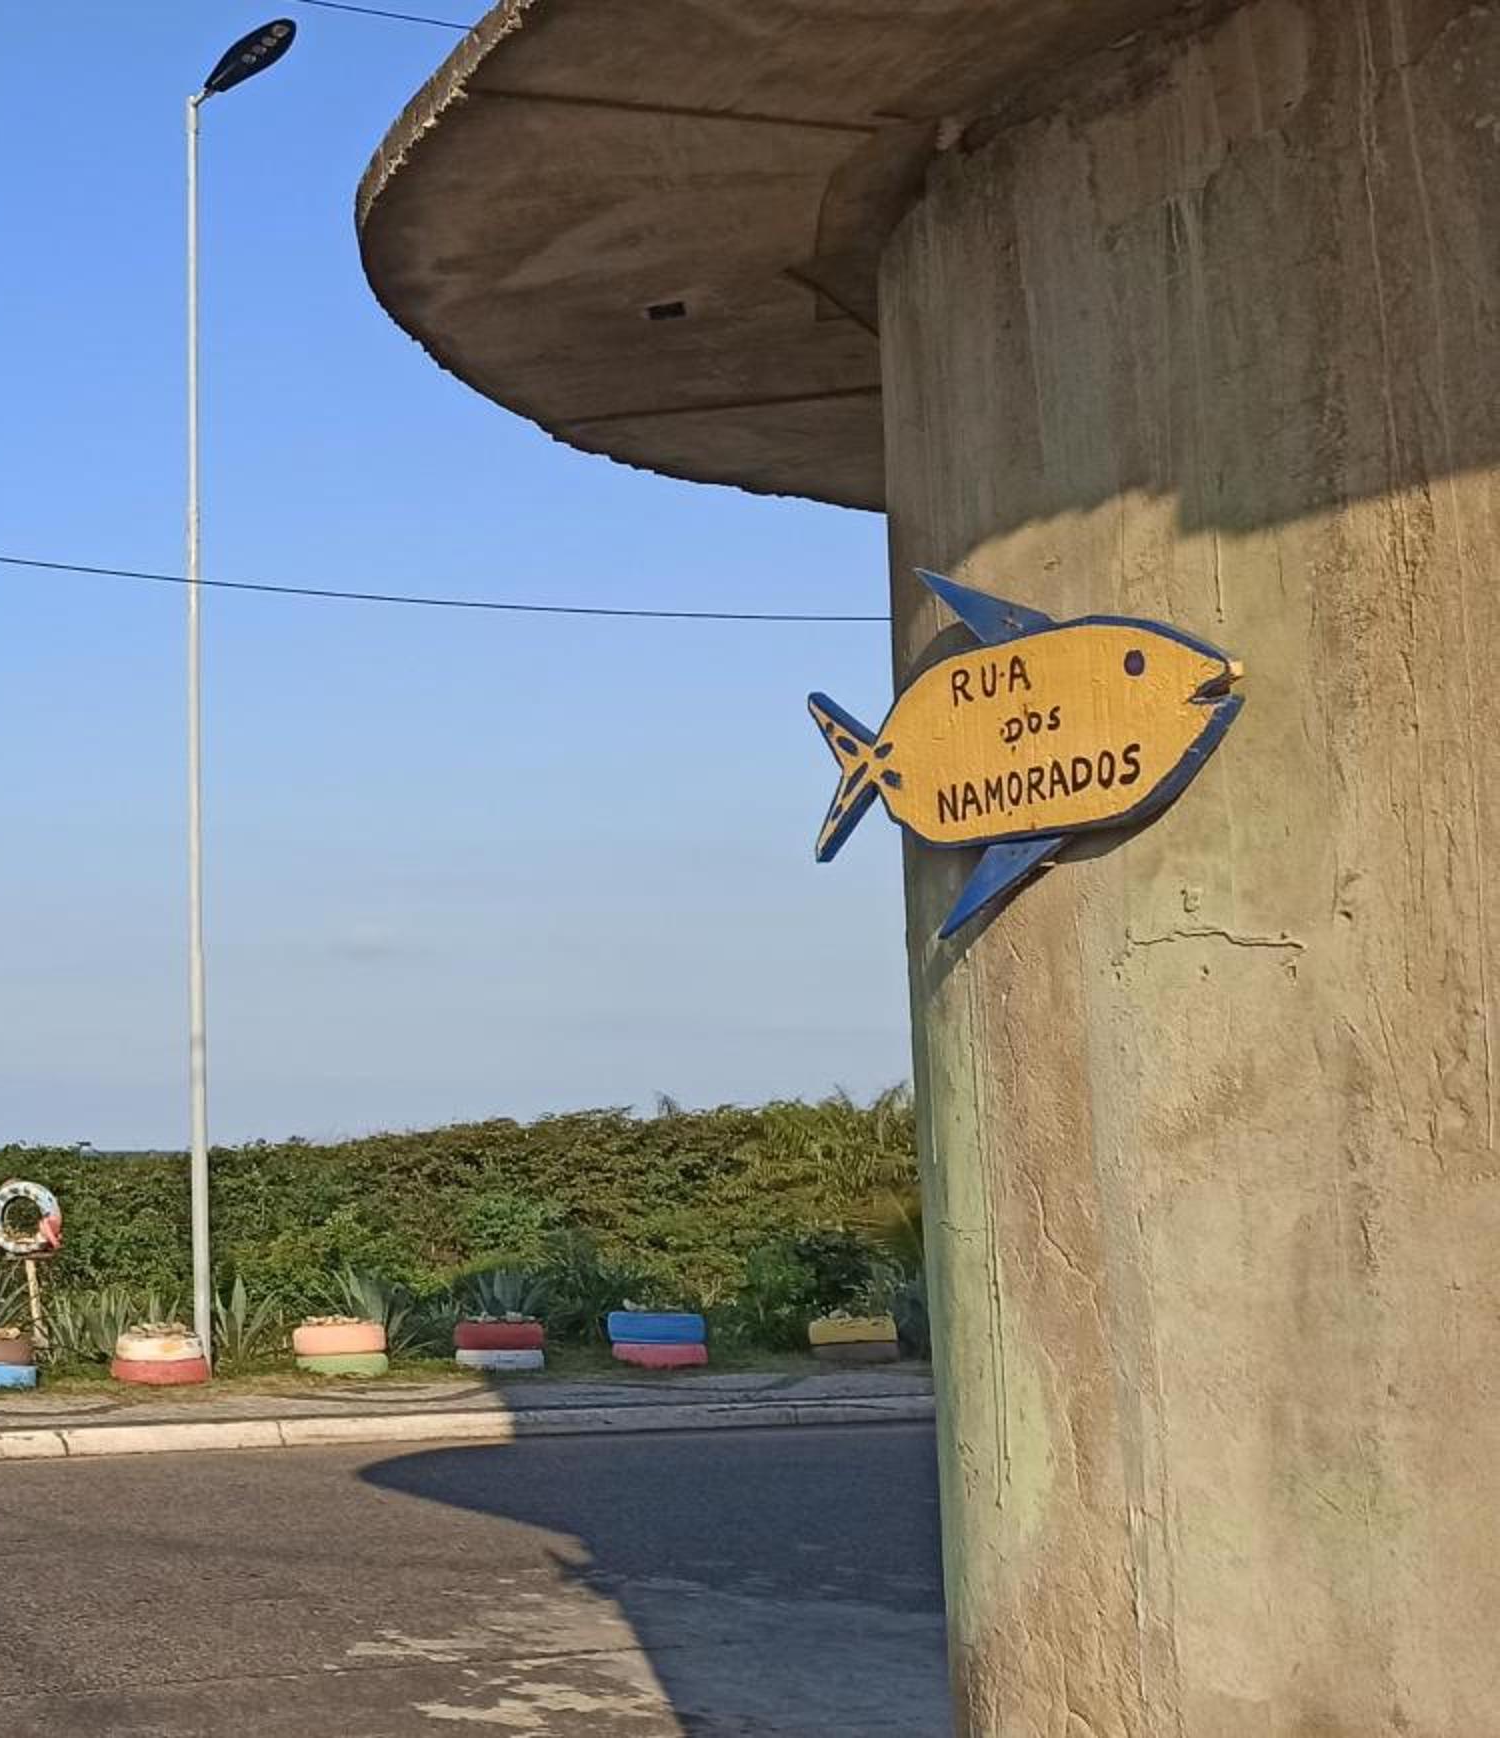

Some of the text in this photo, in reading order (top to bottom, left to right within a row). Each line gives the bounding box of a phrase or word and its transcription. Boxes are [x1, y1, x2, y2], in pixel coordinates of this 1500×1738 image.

[951, 655, 1032, 707] RUA
[1003, 705, 1061, 743] DOS
[937, 743, 1141, 824] NAMORADOS
